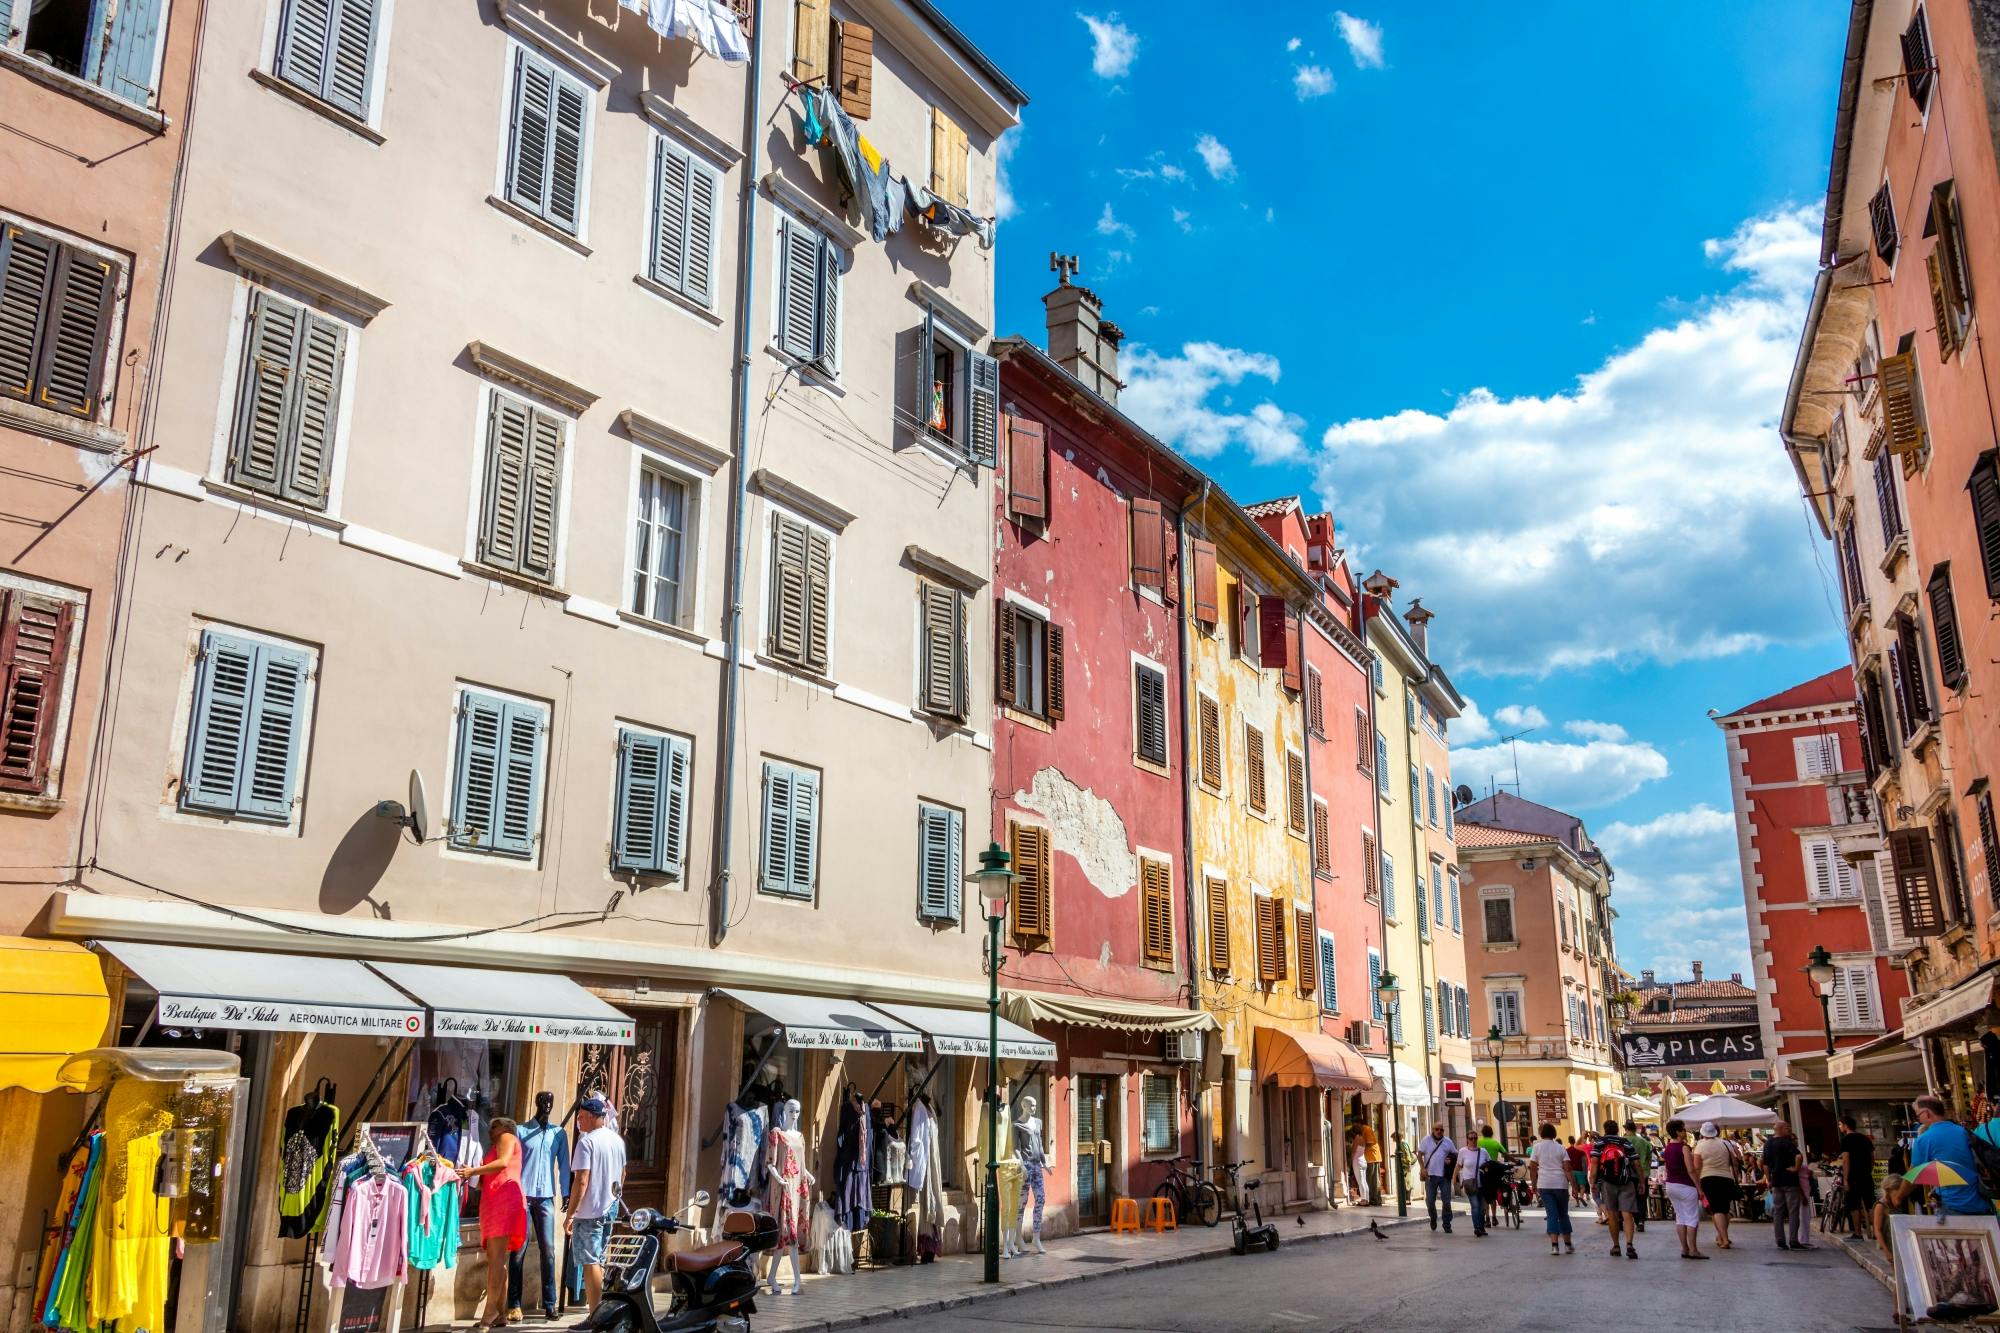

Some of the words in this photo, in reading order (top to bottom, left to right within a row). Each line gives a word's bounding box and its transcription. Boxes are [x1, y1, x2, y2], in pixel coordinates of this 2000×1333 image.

[162, 1003, 217, 1023] Boutique
[248, 1005, 280, 1023] Sada
[289, 1013, 358, 1027] AERONAUTICA
[360, 1017, 403, 1029] MILITARE
[1100, 1014, 1166, 1027] SOUVENIR
[437, 1016, 479, 1034] Boutique
[501, 1018, 526, 1033] Sada
[543, 1024, 570, 1038] Luxury
[569, 1025, 594, 1036] Italian
[593, 1026, 618, 1037] Fashion
[787, 1031, 816, 1047] Boutique
[938, 1040, 962, 1054] Boutique
[1669, 1034, 1755, 1057] PICAS
[1726, 1084, 1751, 1092] MPAS
